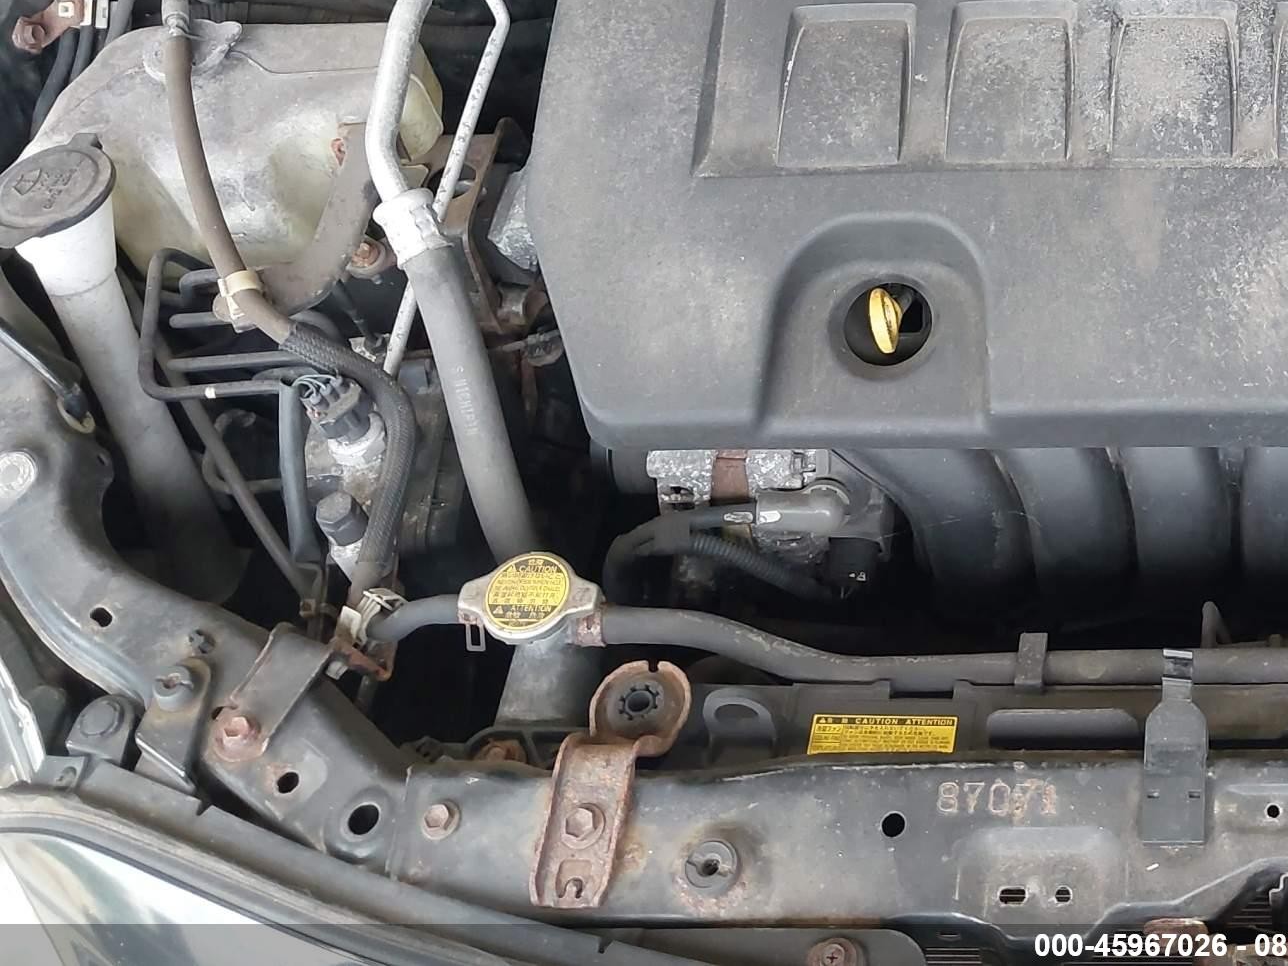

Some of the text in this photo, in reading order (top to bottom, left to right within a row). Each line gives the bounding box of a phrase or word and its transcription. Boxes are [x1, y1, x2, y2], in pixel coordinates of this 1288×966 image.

[519, 565, 557, 573] CAUTION
[855, 718, 899, 726] CAUTION
[905, 718, 953, 726] ATTENTION
